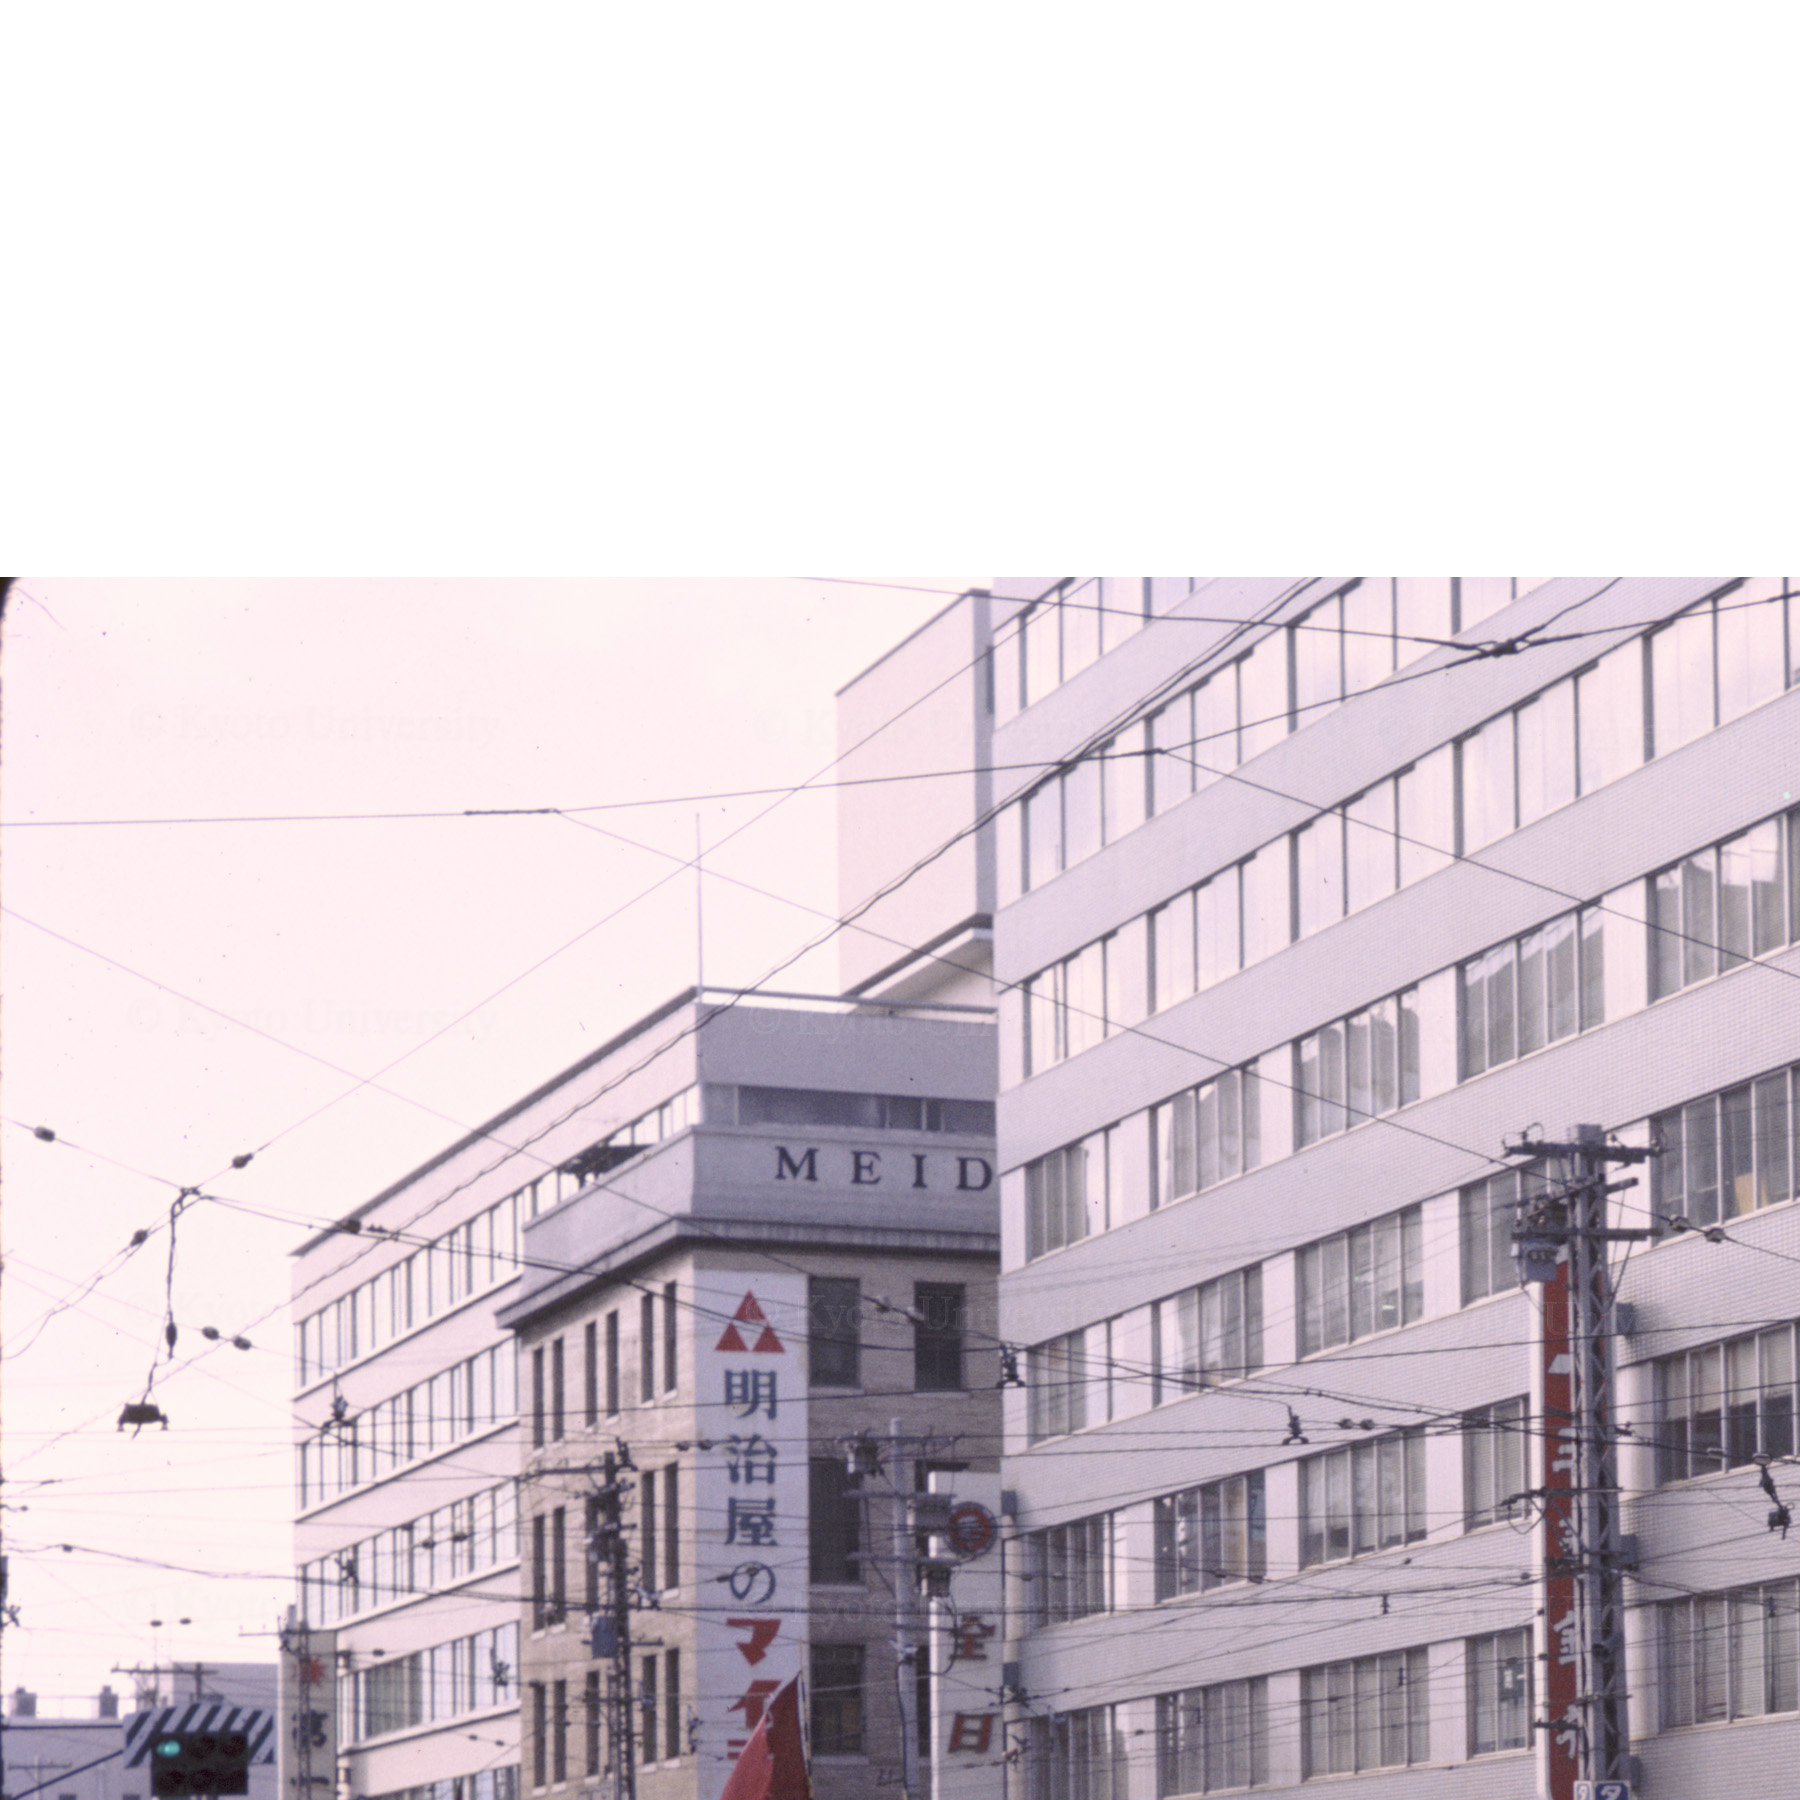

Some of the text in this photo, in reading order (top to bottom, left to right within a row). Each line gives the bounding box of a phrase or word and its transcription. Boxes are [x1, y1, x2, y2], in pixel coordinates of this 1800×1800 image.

[775, 1146, 993, 1192] MEID
[723, 1369, 783, 1760] 明治屋のマイ
